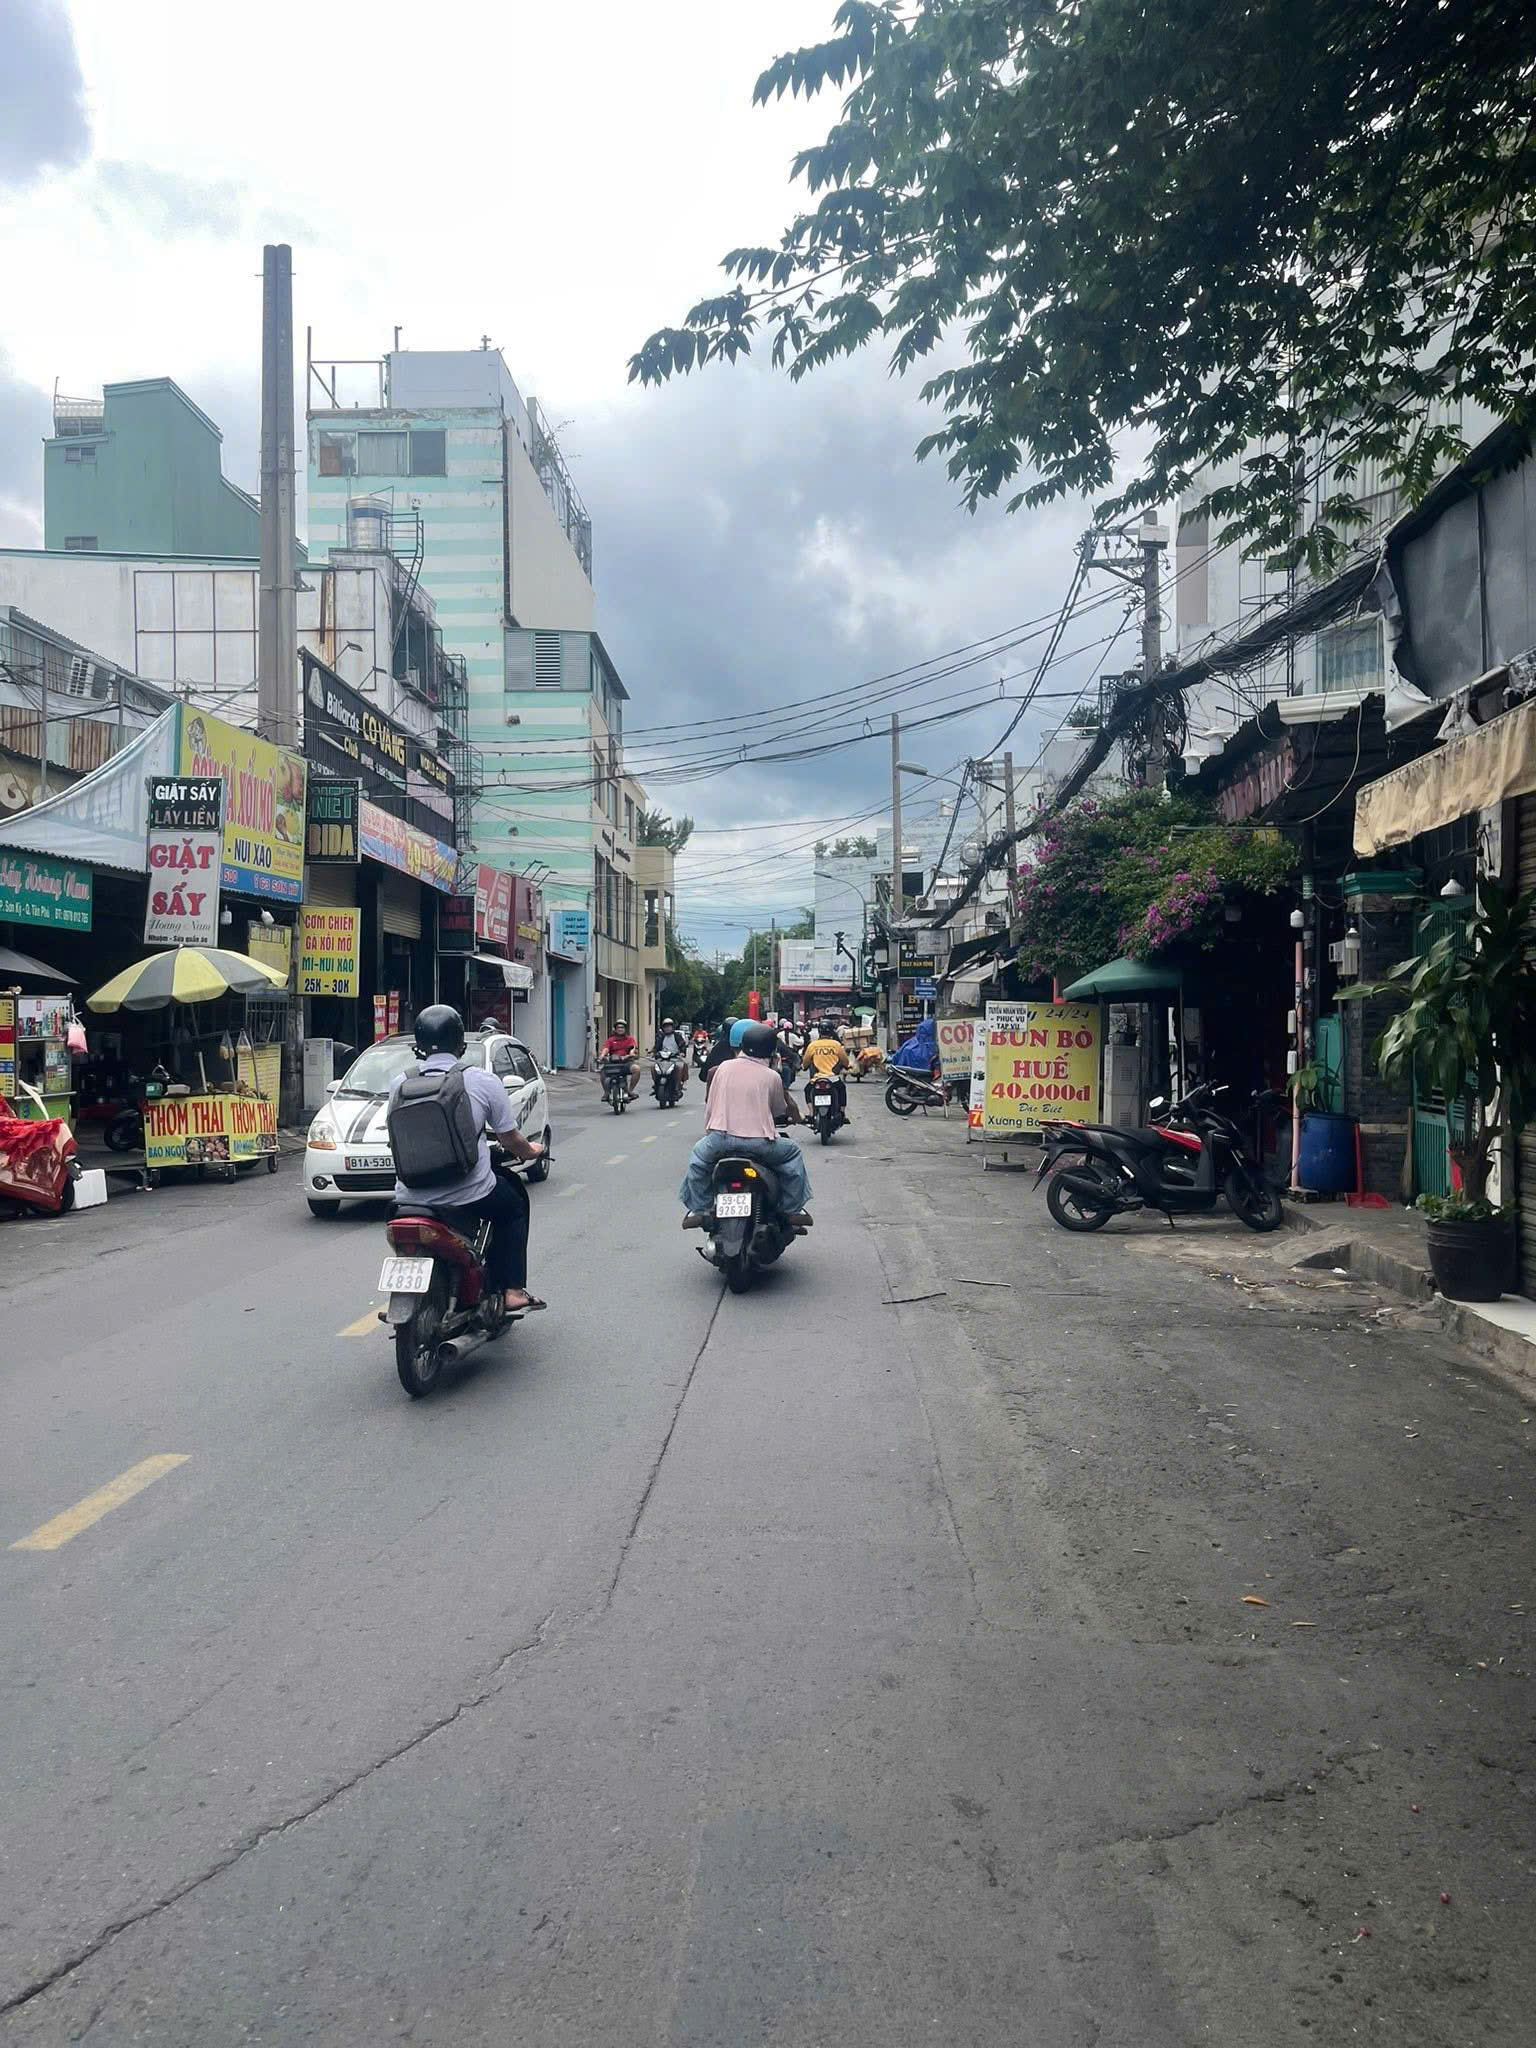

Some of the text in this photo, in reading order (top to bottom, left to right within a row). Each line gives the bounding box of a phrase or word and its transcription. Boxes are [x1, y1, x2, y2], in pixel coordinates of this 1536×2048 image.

[326, 691, 360, 734] Billiards
[155, 780, 217, 804] GIẶT SẤY
[313, 786, 353, 819] NET
[155, 804, 216, 825] LẤY LIỀN
[234, 837, 251, 864] NUI
[253, 839, 272, 869] XÀO
[309, 823, 355, 857] BIDA
[149, 837, 215, 876] GIẶT
[152, 881, 207, 917] SẤY
[304, 914, 326, 929] CƠM
[305, 933, 318, 951] GÀ
[304, 977, 321, 993] 25K
[332, 979, 350, 994] 30K
[1045, 1007, 1090, 1020] 24/24
[1056, 1025, 1093, 1049] BÒ
[1012, 1052, 1071, 1080] HUẾ
[149, 1096, 226, 1137] THƠM THÁI
[386, 1275, 423, 1289] 4830
